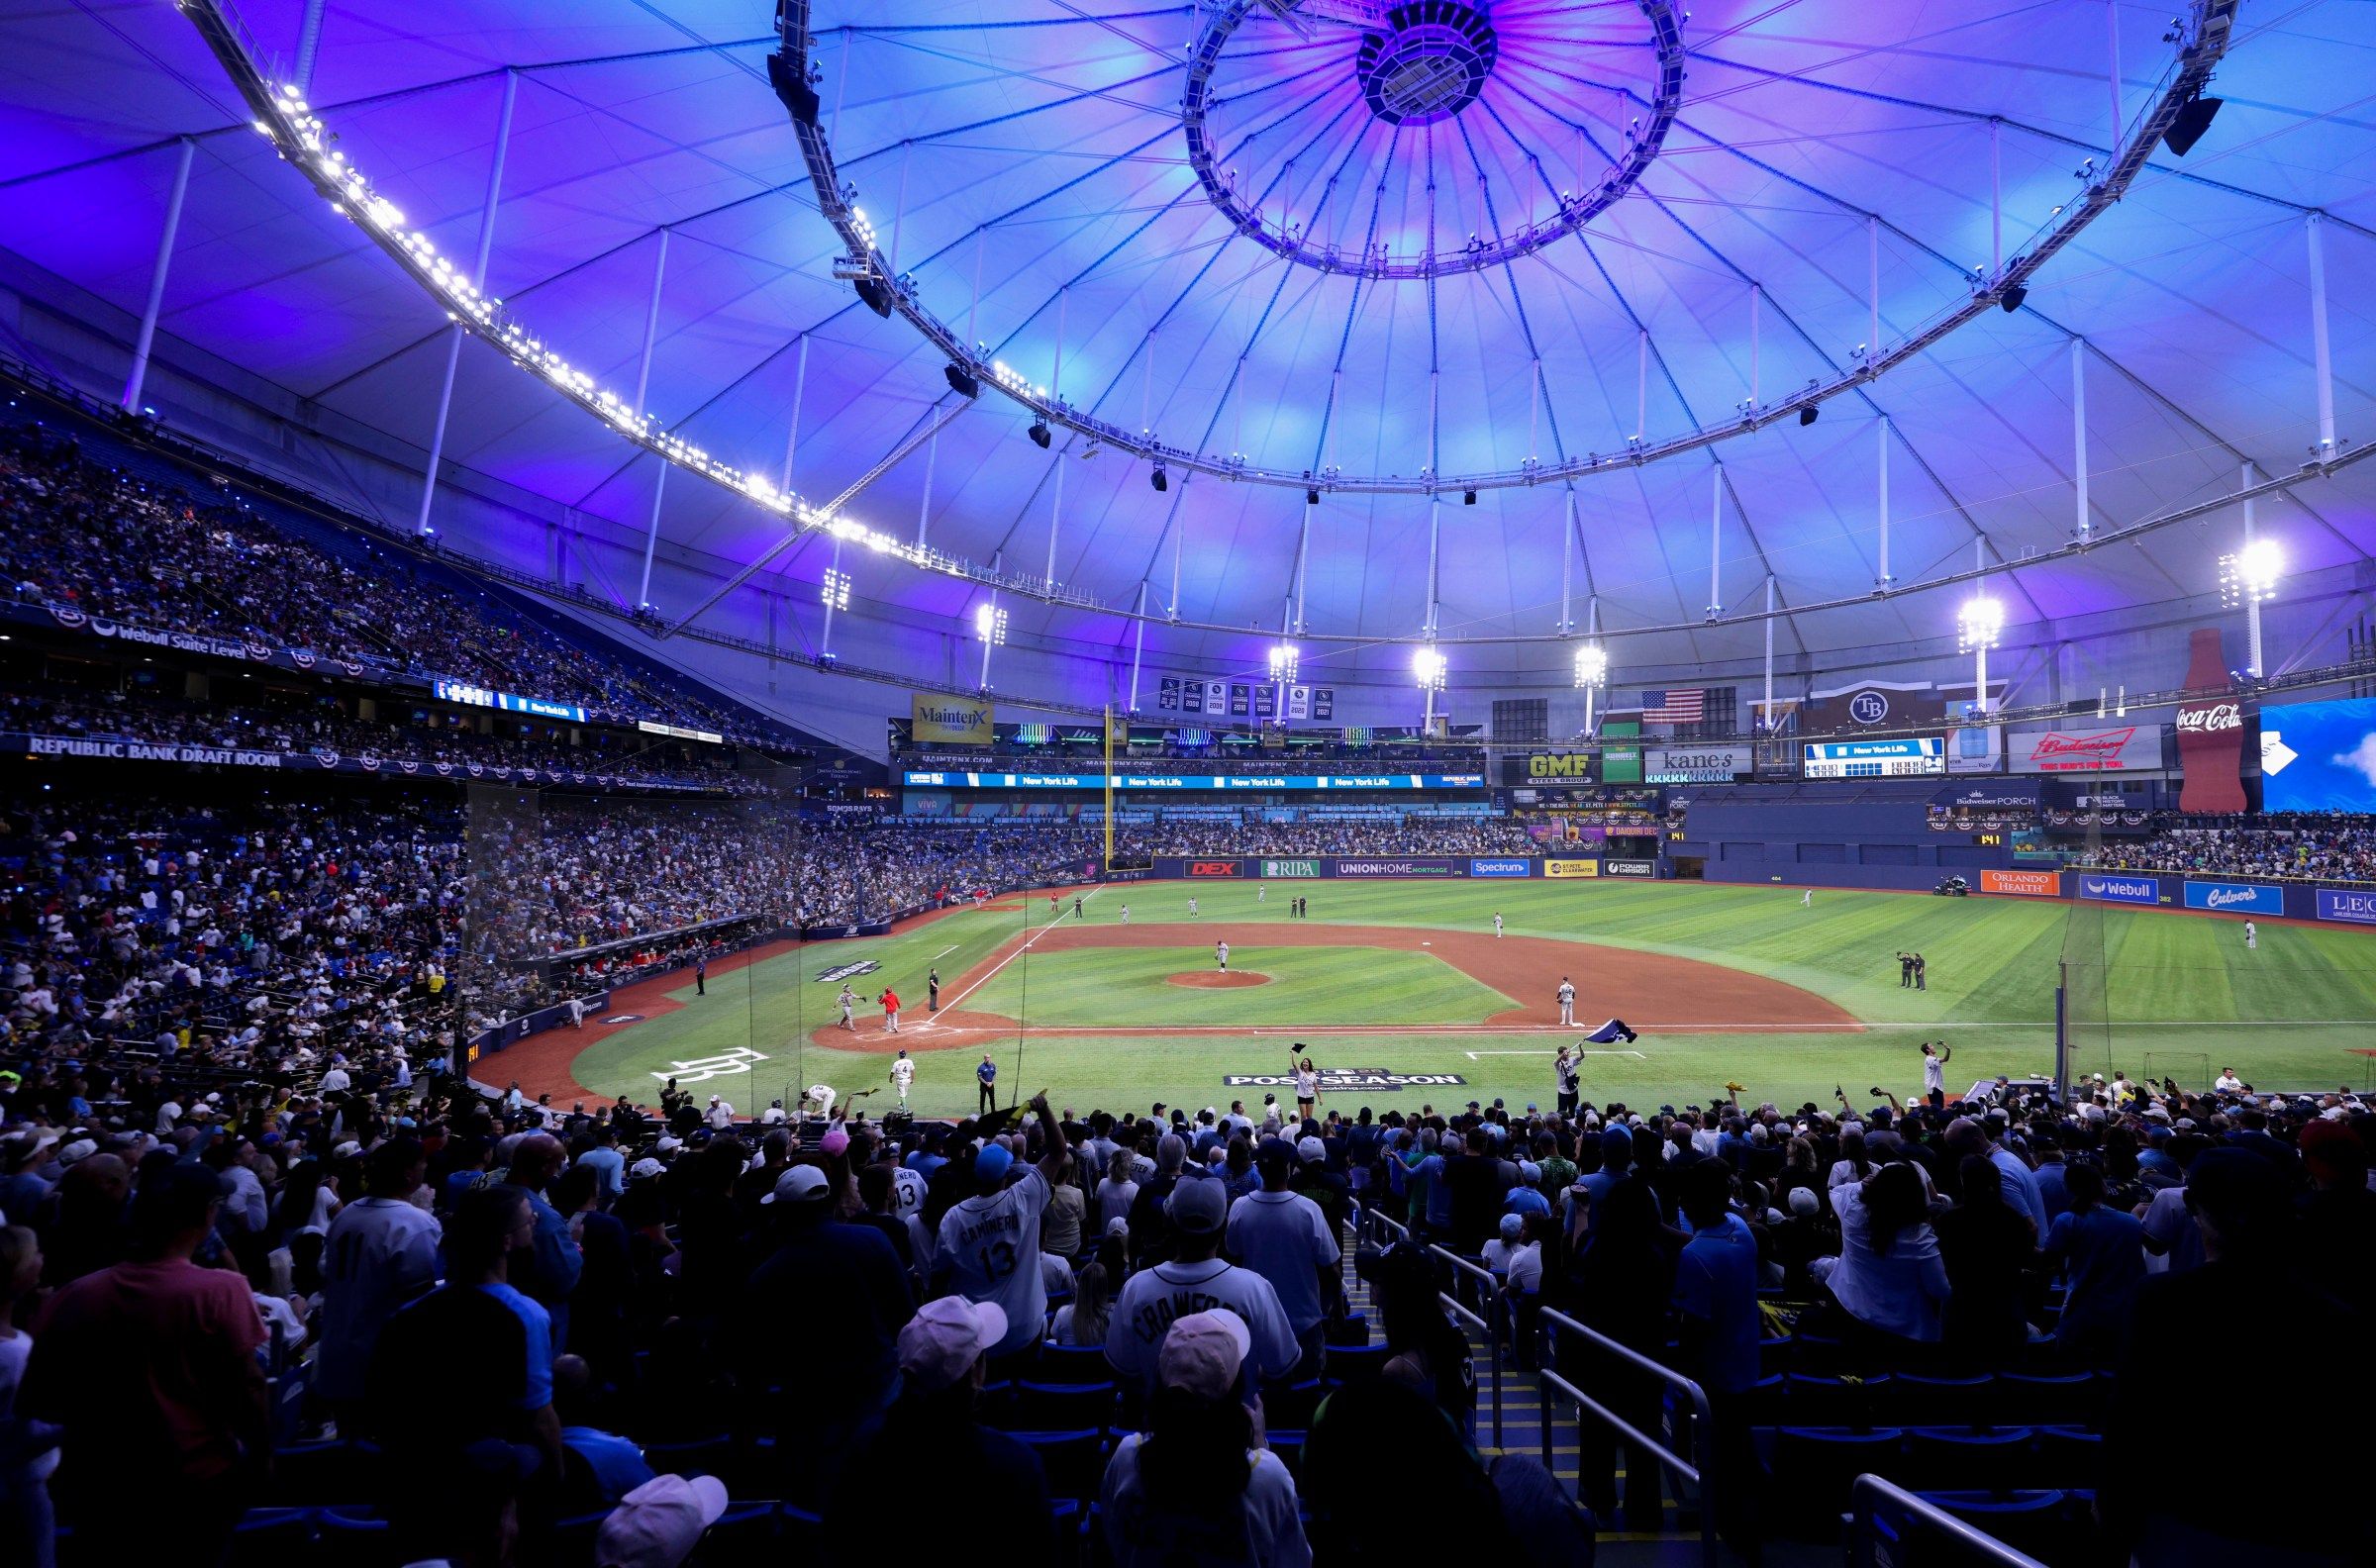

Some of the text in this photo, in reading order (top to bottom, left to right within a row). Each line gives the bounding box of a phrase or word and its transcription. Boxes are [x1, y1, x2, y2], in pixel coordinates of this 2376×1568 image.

[119, 626, 246, 660] Webull Suite Level
[1857, 698, 1882, 718] TB
[920, 707, 987, 730] MaintenX
[2176, 704, 2242, 733] Coca-Cola
[30, 737, 280, 767] REPUBLIC BANK DRAFT ROOM
[1853, 745, 1872, 754] New
[1892, 744, 1908, 753] Life
[2037, 739, 2125, 753] Budweiser
[1530, 754, 1589, 777] GMF
[1663, 751, 1733, 769] kane's
[1023, 776, 1041, 785] New
[1062, 777, 1078, 786] Life
[1232, 778, 1285, 787] New York Life
[1335, 778, 1390, 787] New York Life
[1191, 862, 1237, 875] DEX
[1280, 862, 1315, 876] RIPA
[1475, 862, 1520, 874] Spectrum
[1992, 872, 2048, 883] ORLANDO
[1999, 881, 2043, 893] HEALTH
[2108, 881, 2150, 897] Webull
[2207, 887, 2257, 907] Culver's
[1231, 1075, 1461, 1085] POSSEASON
[1131, 1162, 1148, 1174] EFER
[895, 1171, 917, 1181] INERO
[895, 1184, 916, 1209] 13
[960, 1214, 1019, 1246] CAMINERO
[979, 1240, 1016, 1283] 13
[1133, 1291, 1250, 1344] CRAWFO
